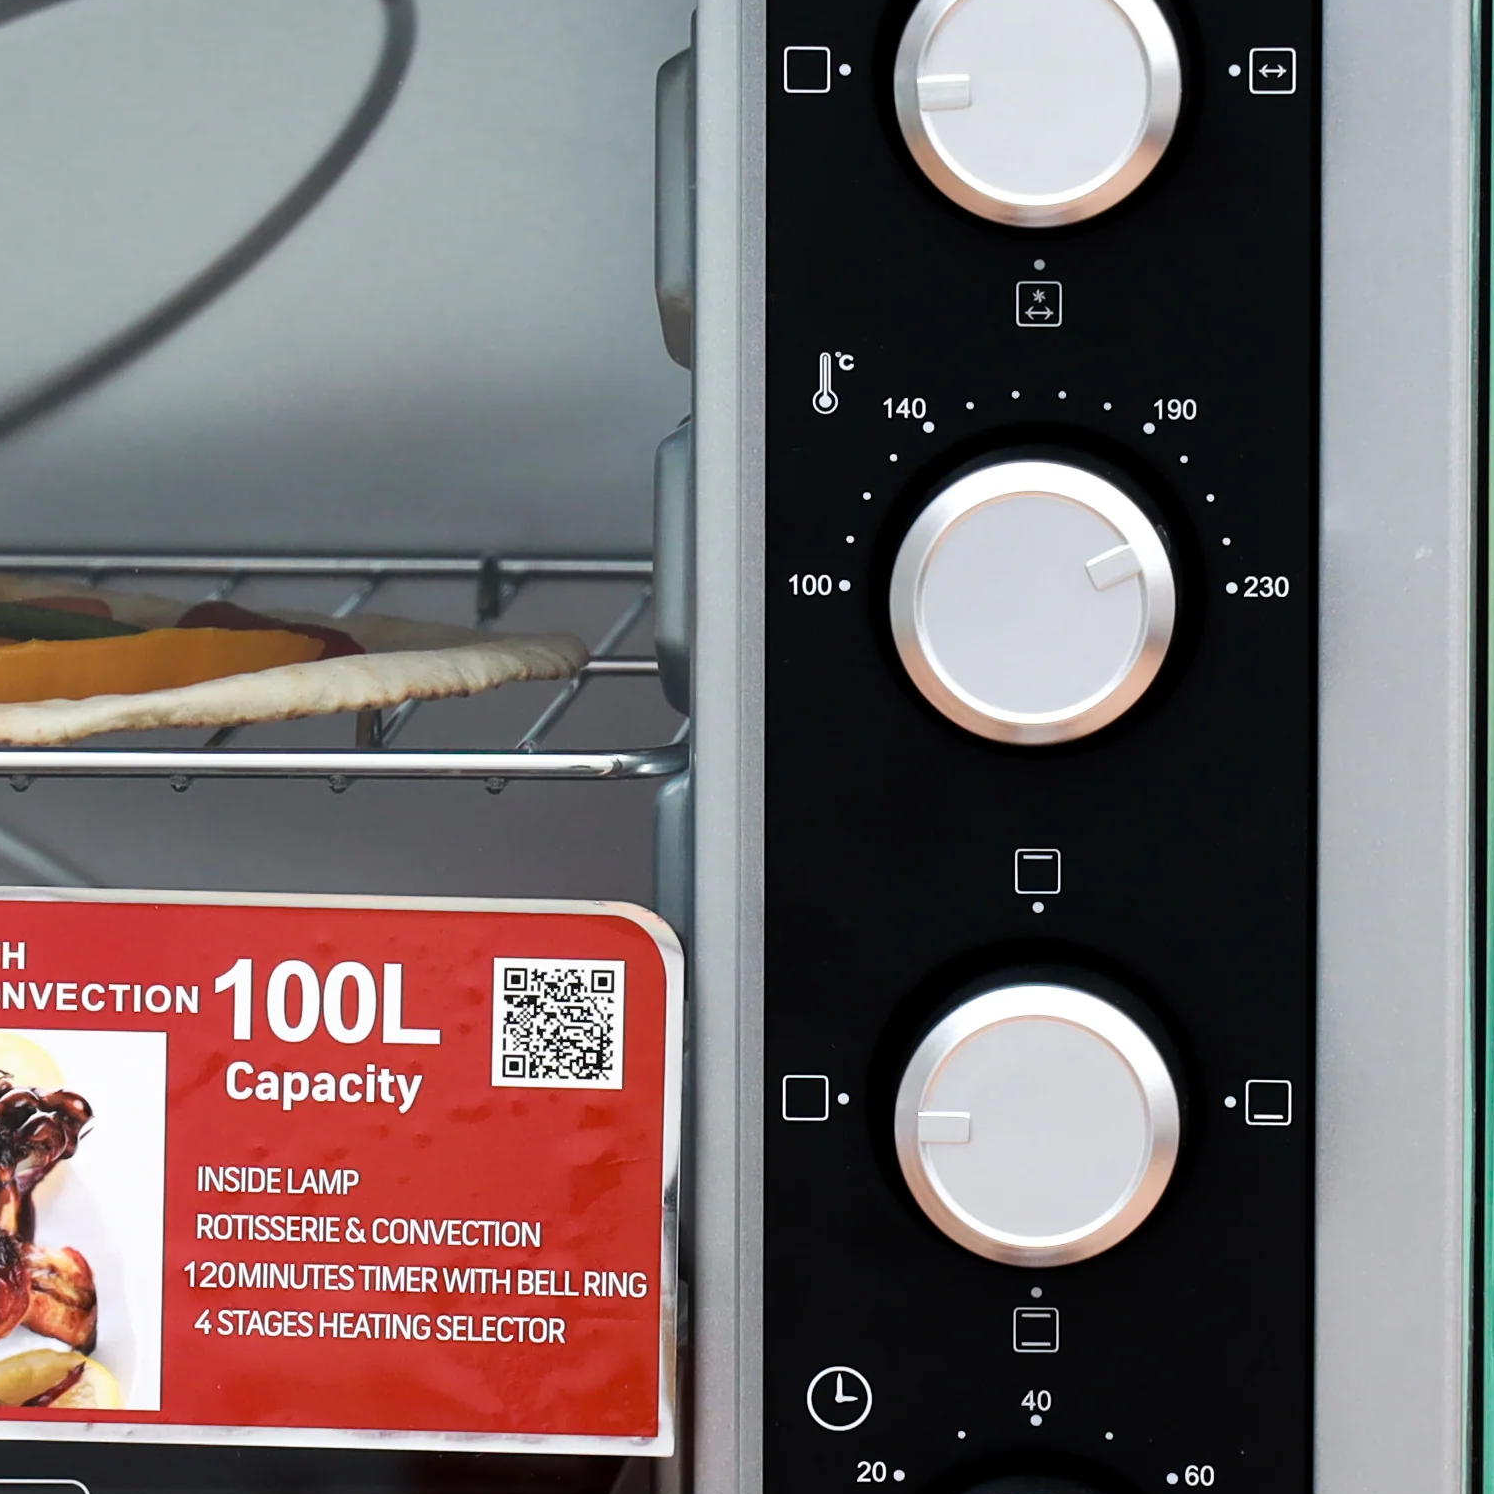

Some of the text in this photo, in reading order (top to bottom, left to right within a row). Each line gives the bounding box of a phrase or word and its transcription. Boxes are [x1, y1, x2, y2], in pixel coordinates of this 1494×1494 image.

[882, 397, 927, 419] 140
[1153, 398, 1197, 421] 190
[788, 573, 833, 596] 100
[1243, 575, 1290, 598] 230
[214, 958, 441, 1045] 100L
[226, 1061, 423, 1114] Capacity
[197, 1165, 359, 1195] INSIDE LAMP
[196, 1213, 541, 1248] ROTISSERIE & CONVECTION
[358, 1265, 438, 1293] TIMER
[442, 1267, 511, 1295] WITH
[517, 1269, 580, 1297] BELL
[584, 1270, 647, 1298] RING
[194, 1309, 566, 1344] 4 STAGES HEATING SELECTOR
[1020, 1389, 1052, 1412] 40
[856, 1460, 887, 1483] 20
[1184, 1464, 1215, 1487] 60
